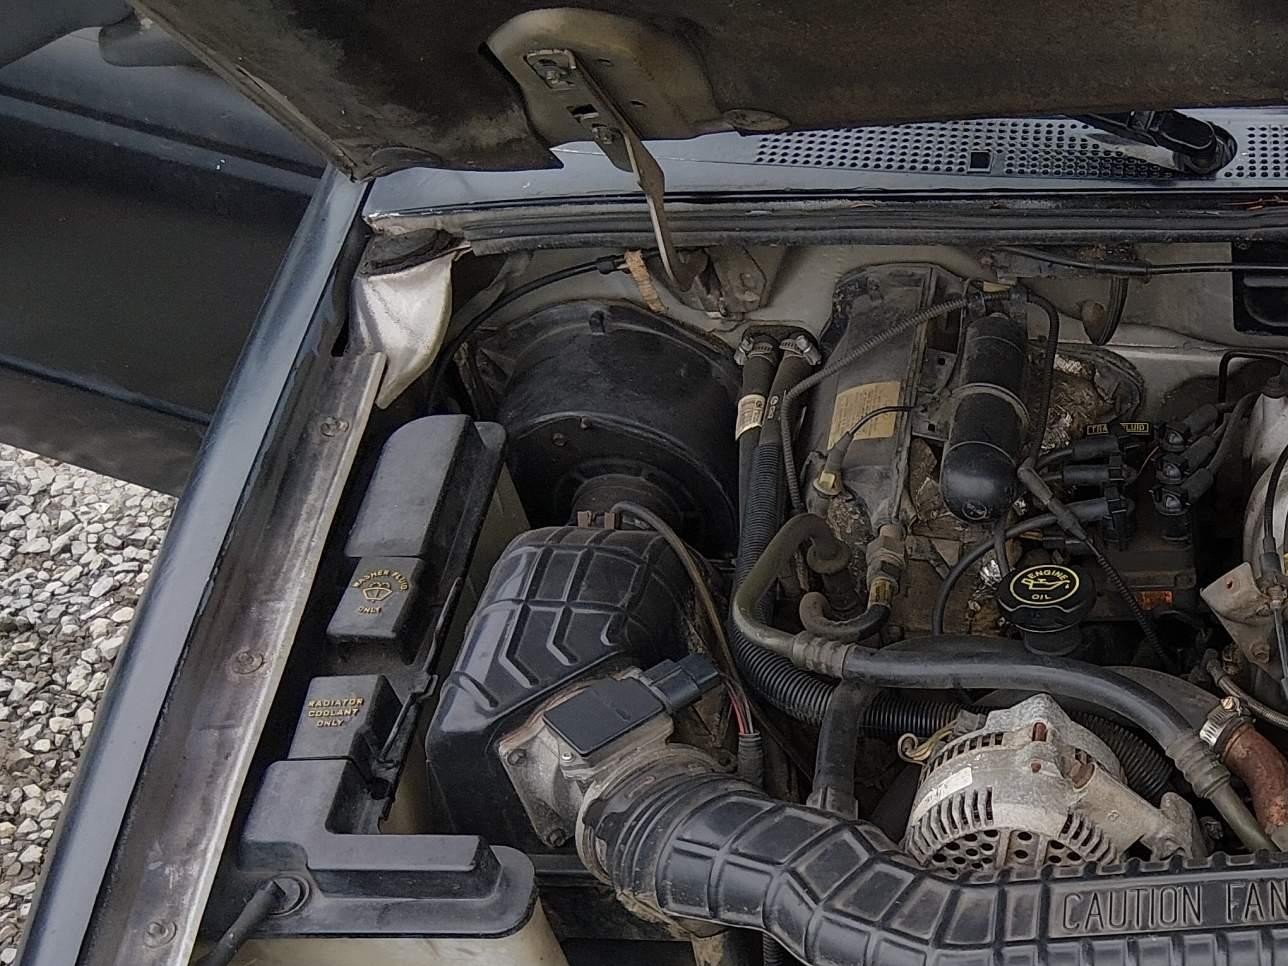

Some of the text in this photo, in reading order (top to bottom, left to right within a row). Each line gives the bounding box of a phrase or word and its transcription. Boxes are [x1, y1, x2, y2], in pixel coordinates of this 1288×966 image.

[1027, 569, 1069, 581] ENGINE
[391, 571, 409, 591] FLUID
[355, 606, 382, 614] ONLY
[308, 697, 364, 708] RADIATOR
[308, 708, 360, 717] COOLANT
[316, 719, 345, 728] ONLY
[1063, 885, 1203, 932] CAUTION
